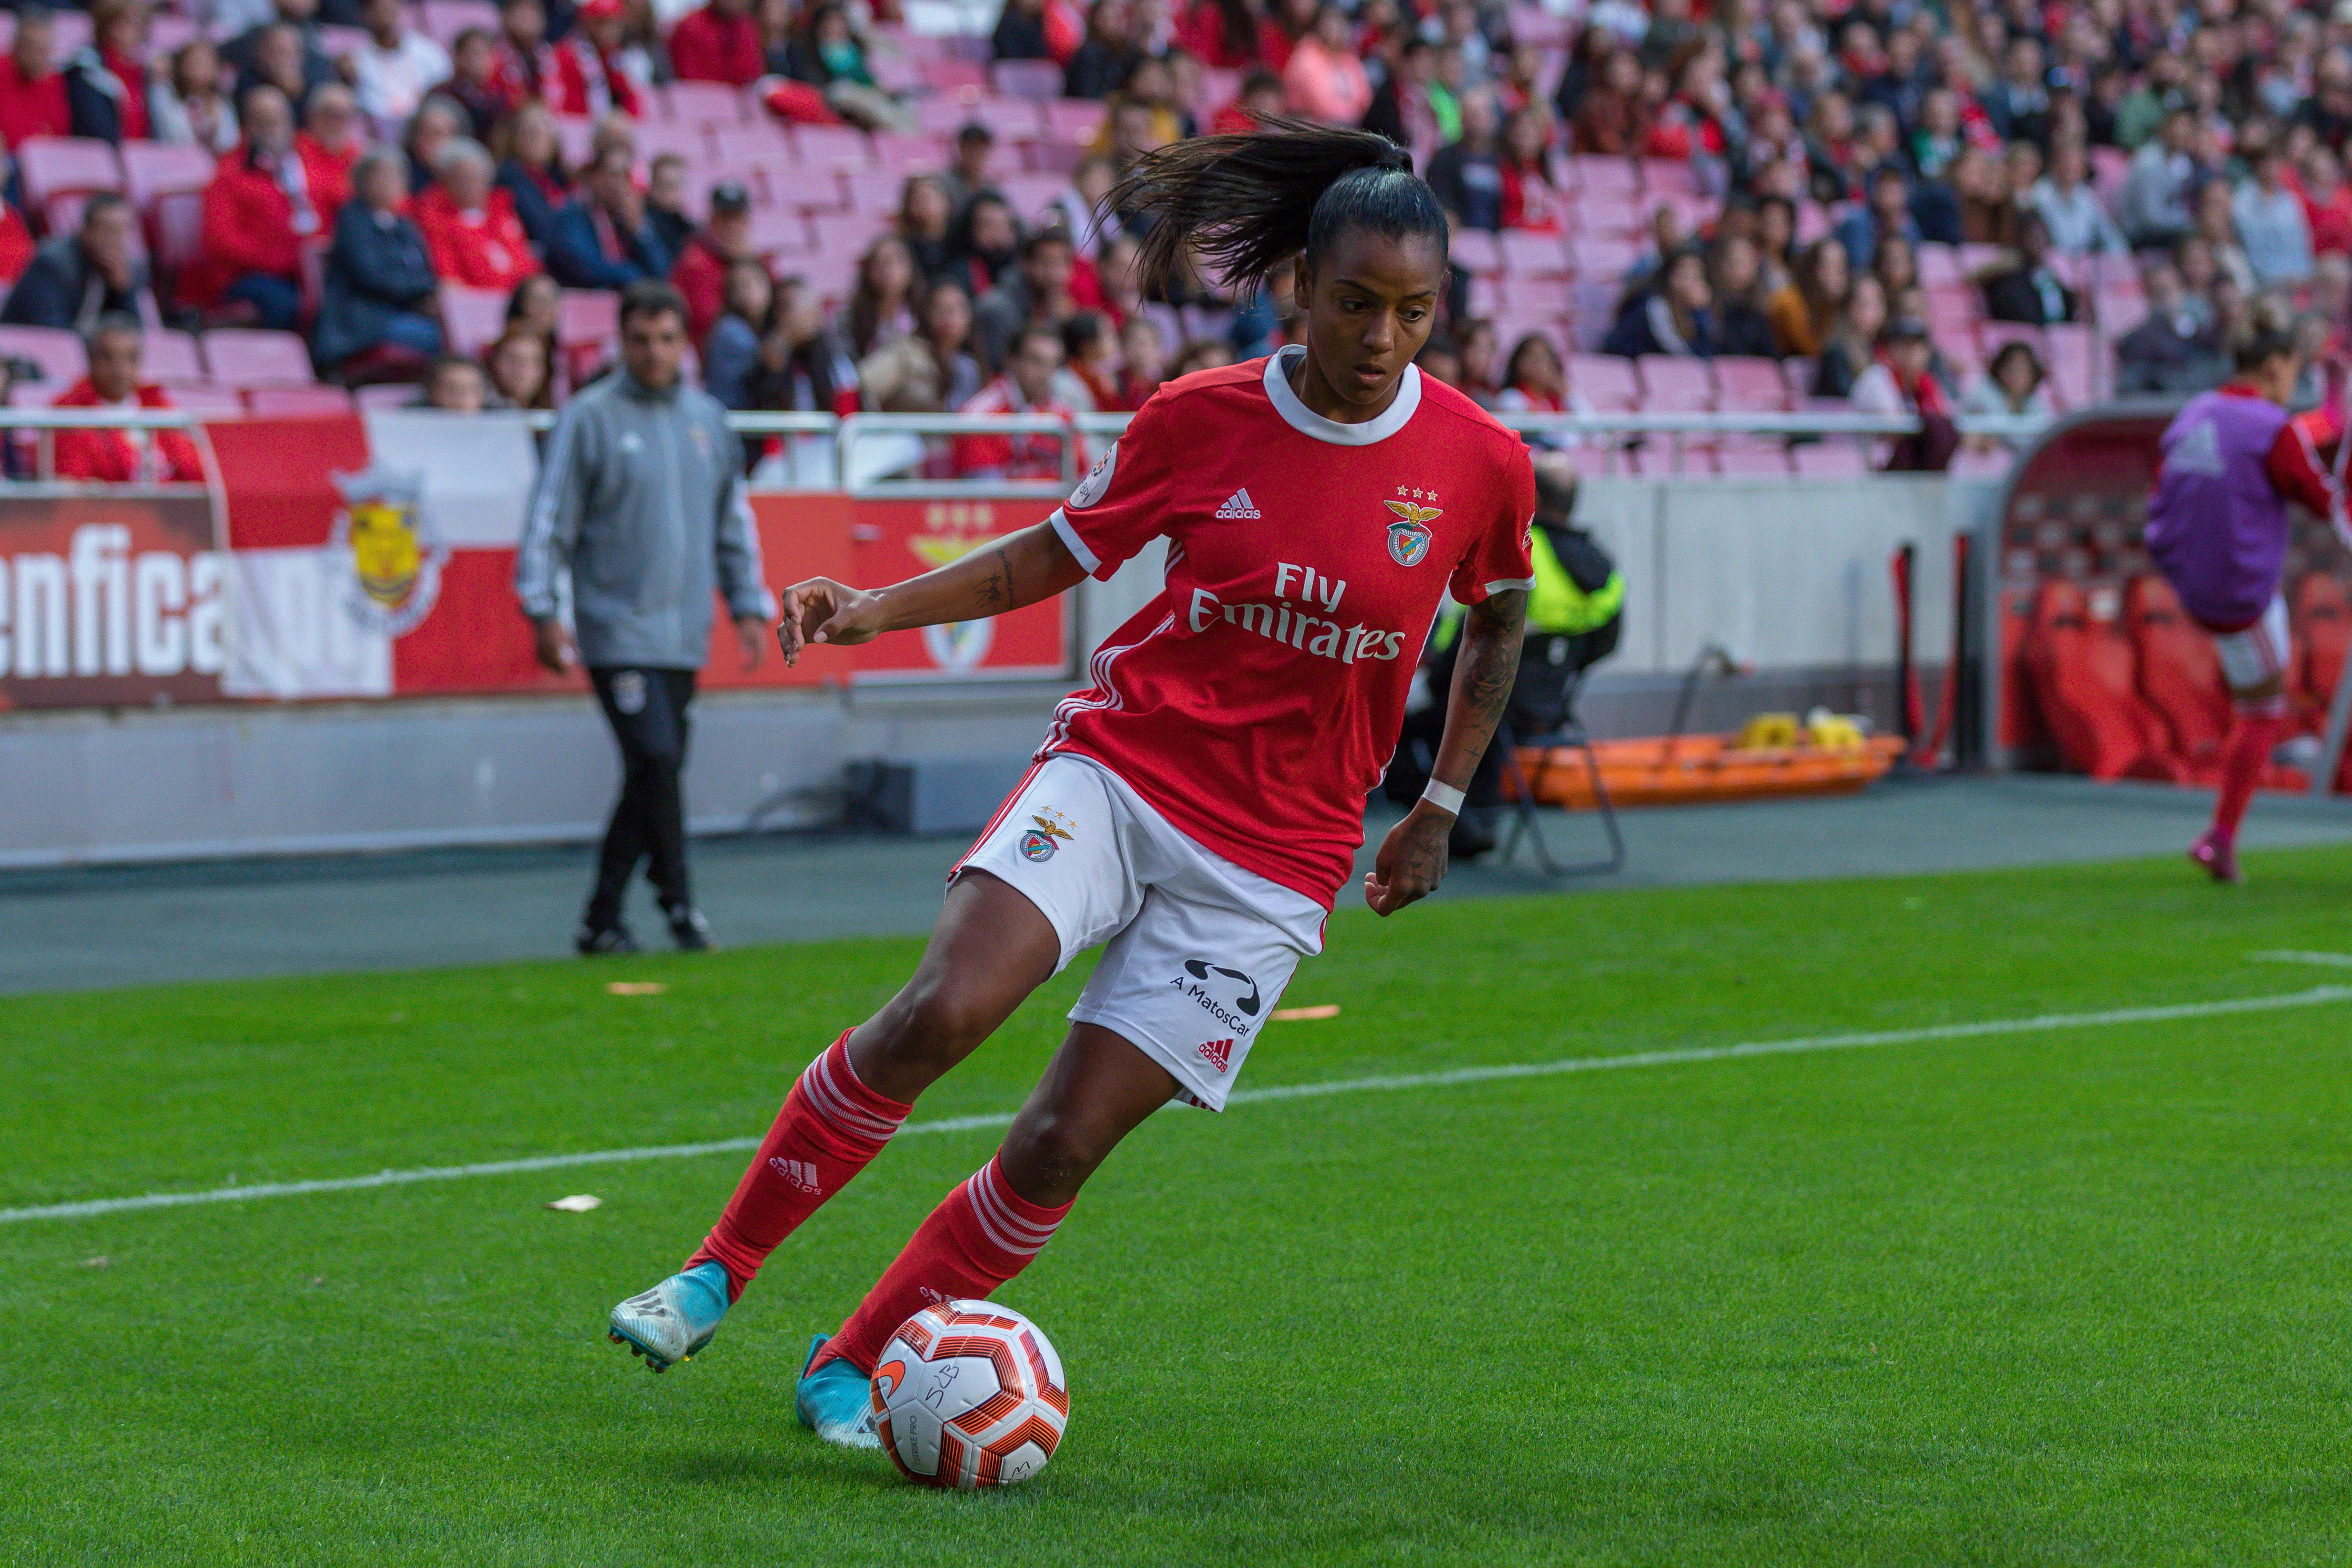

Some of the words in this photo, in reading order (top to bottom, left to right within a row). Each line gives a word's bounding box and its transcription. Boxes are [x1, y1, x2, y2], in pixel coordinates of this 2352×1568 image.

[1215, 507, 1261, 519] adidas
[1275, 562, 1346, 613] Fly
[1189, 588, 1406, 664] Emirates
[1170, 976, 1184, 990] A
[1187, 984, 1250, 1037] MatosCar
[1198, 1043, 1228, 1073] adidas
[769, 1158, 823, 1195] adidas
